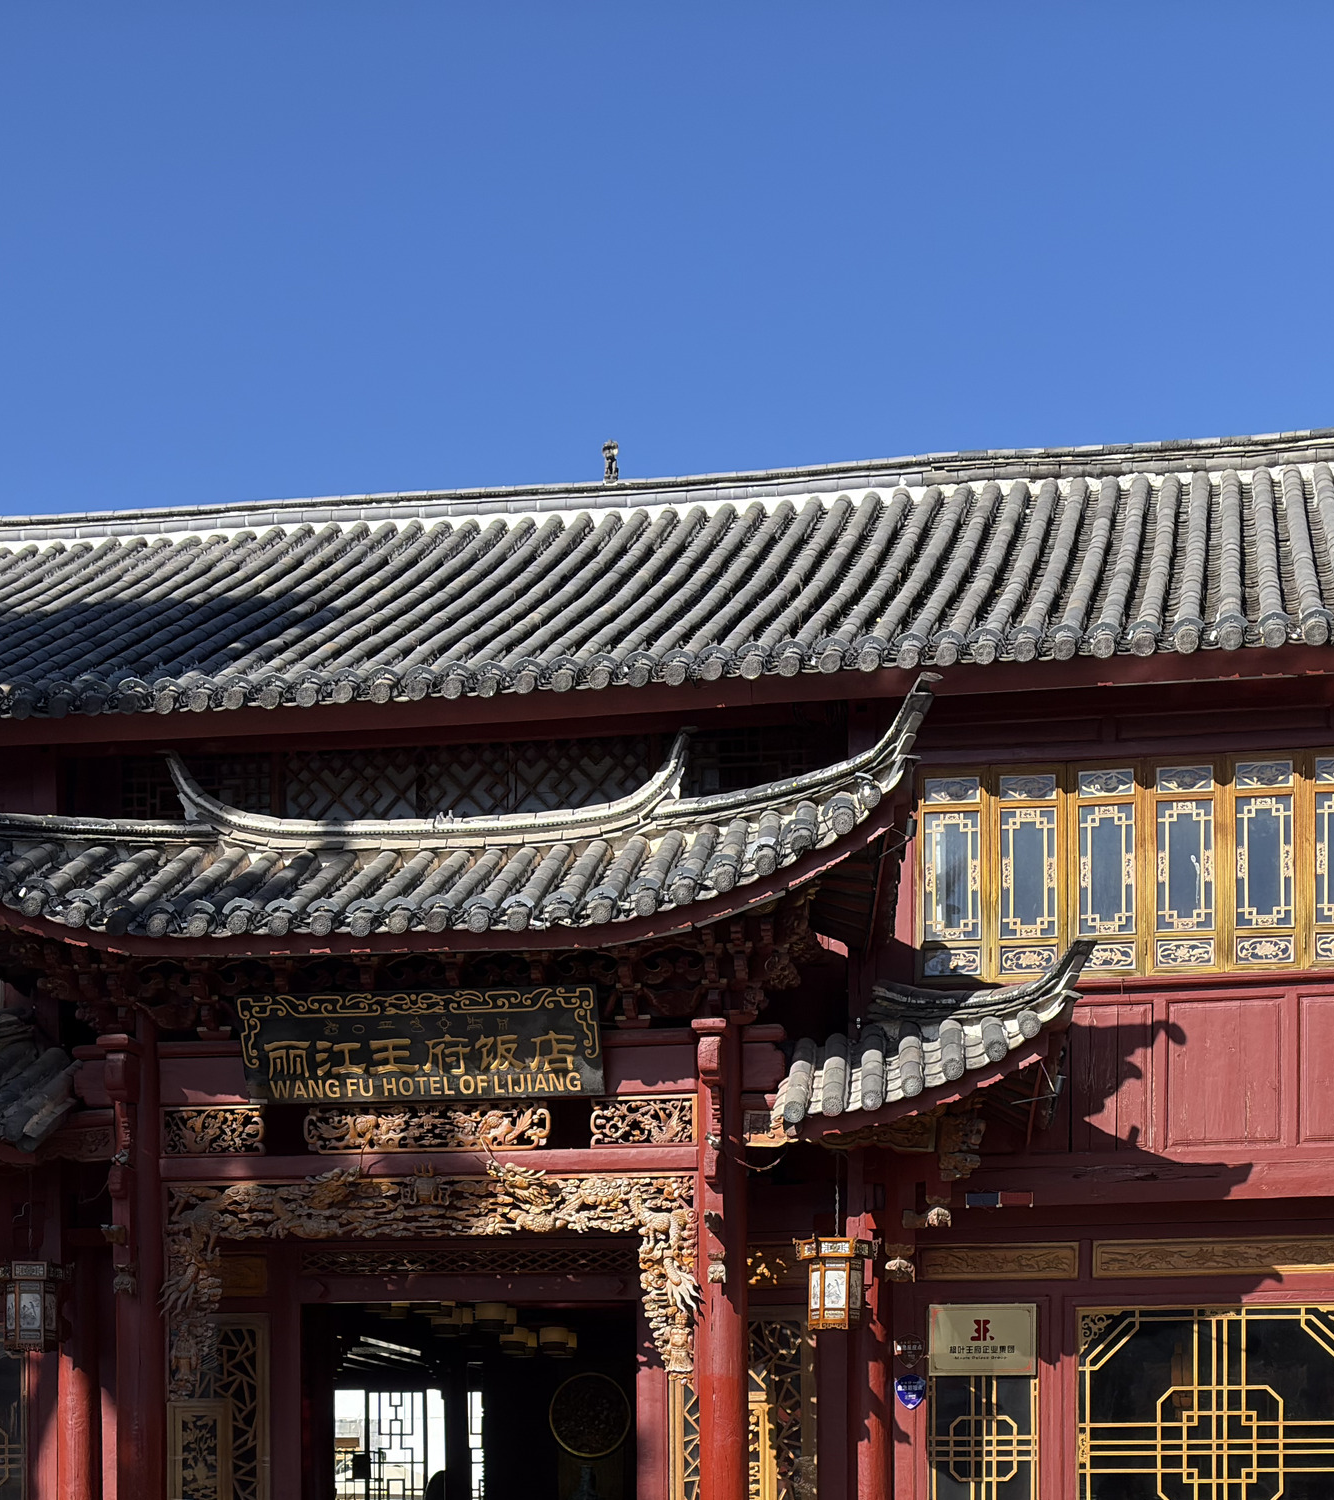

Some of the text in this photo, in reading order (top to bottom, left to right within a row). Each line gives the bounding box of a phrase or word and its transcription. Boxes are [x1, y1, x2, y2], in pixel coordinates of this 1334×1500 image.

[262, 1030, 578, 1078] 丽江王府饭店
[270, 1072, 582, 1098] WANG FU HOTEL OF LIJIANG
